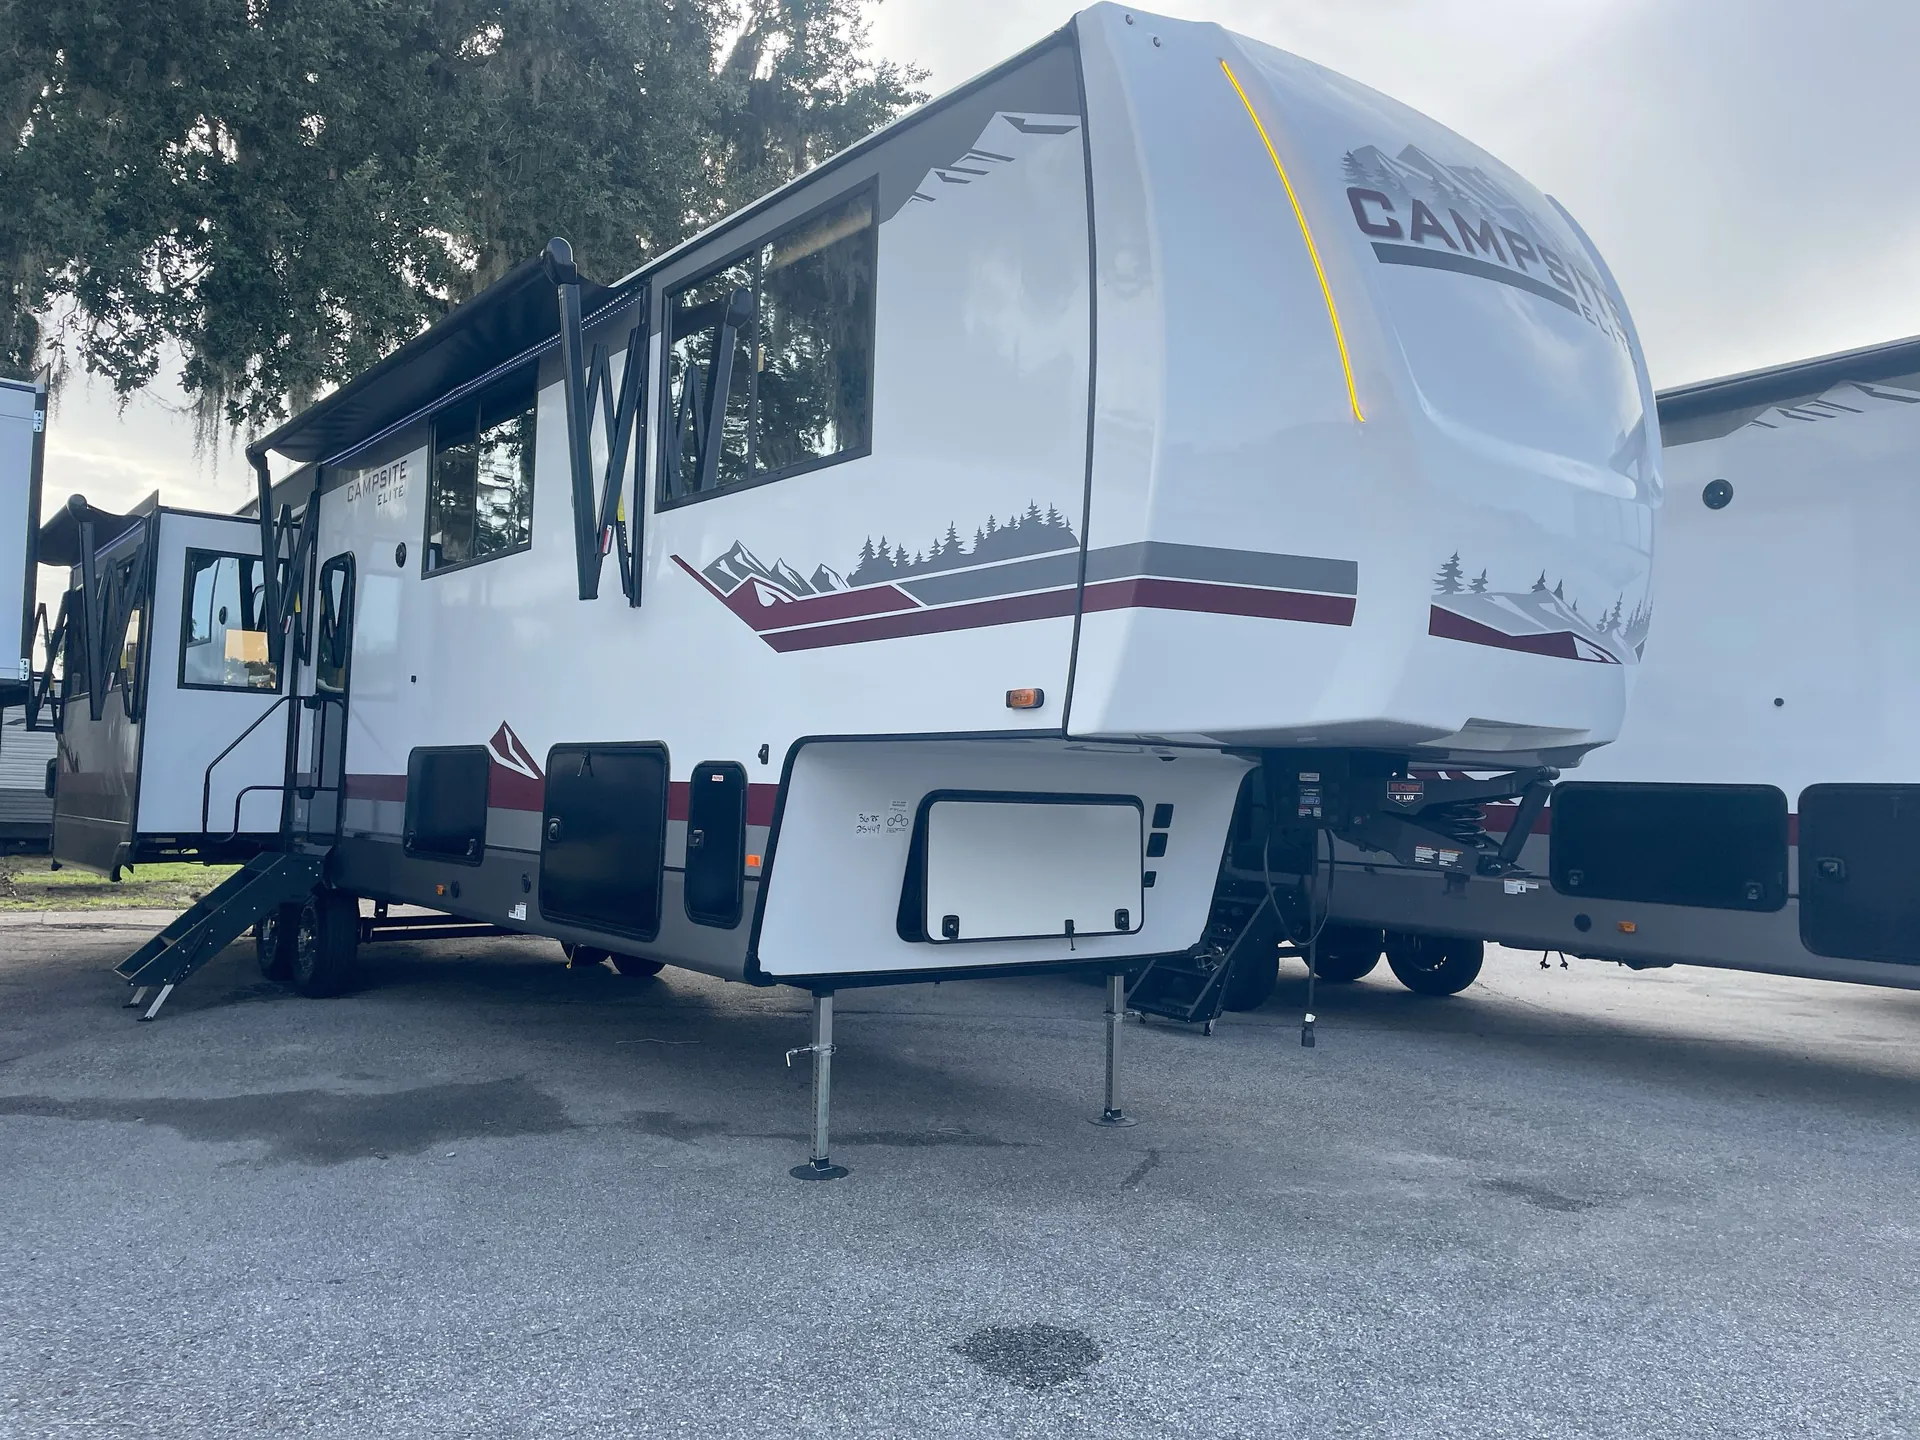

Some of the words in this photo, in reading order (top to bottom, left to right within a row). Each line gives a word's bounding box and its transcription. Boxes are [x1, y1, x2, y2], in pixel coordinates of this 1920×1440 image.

[1347, 187, 1629, 339] CAMPSITE
[347, 460, 407, 502] CAMPSITE
[377, 485, 404, 506] ELITE
